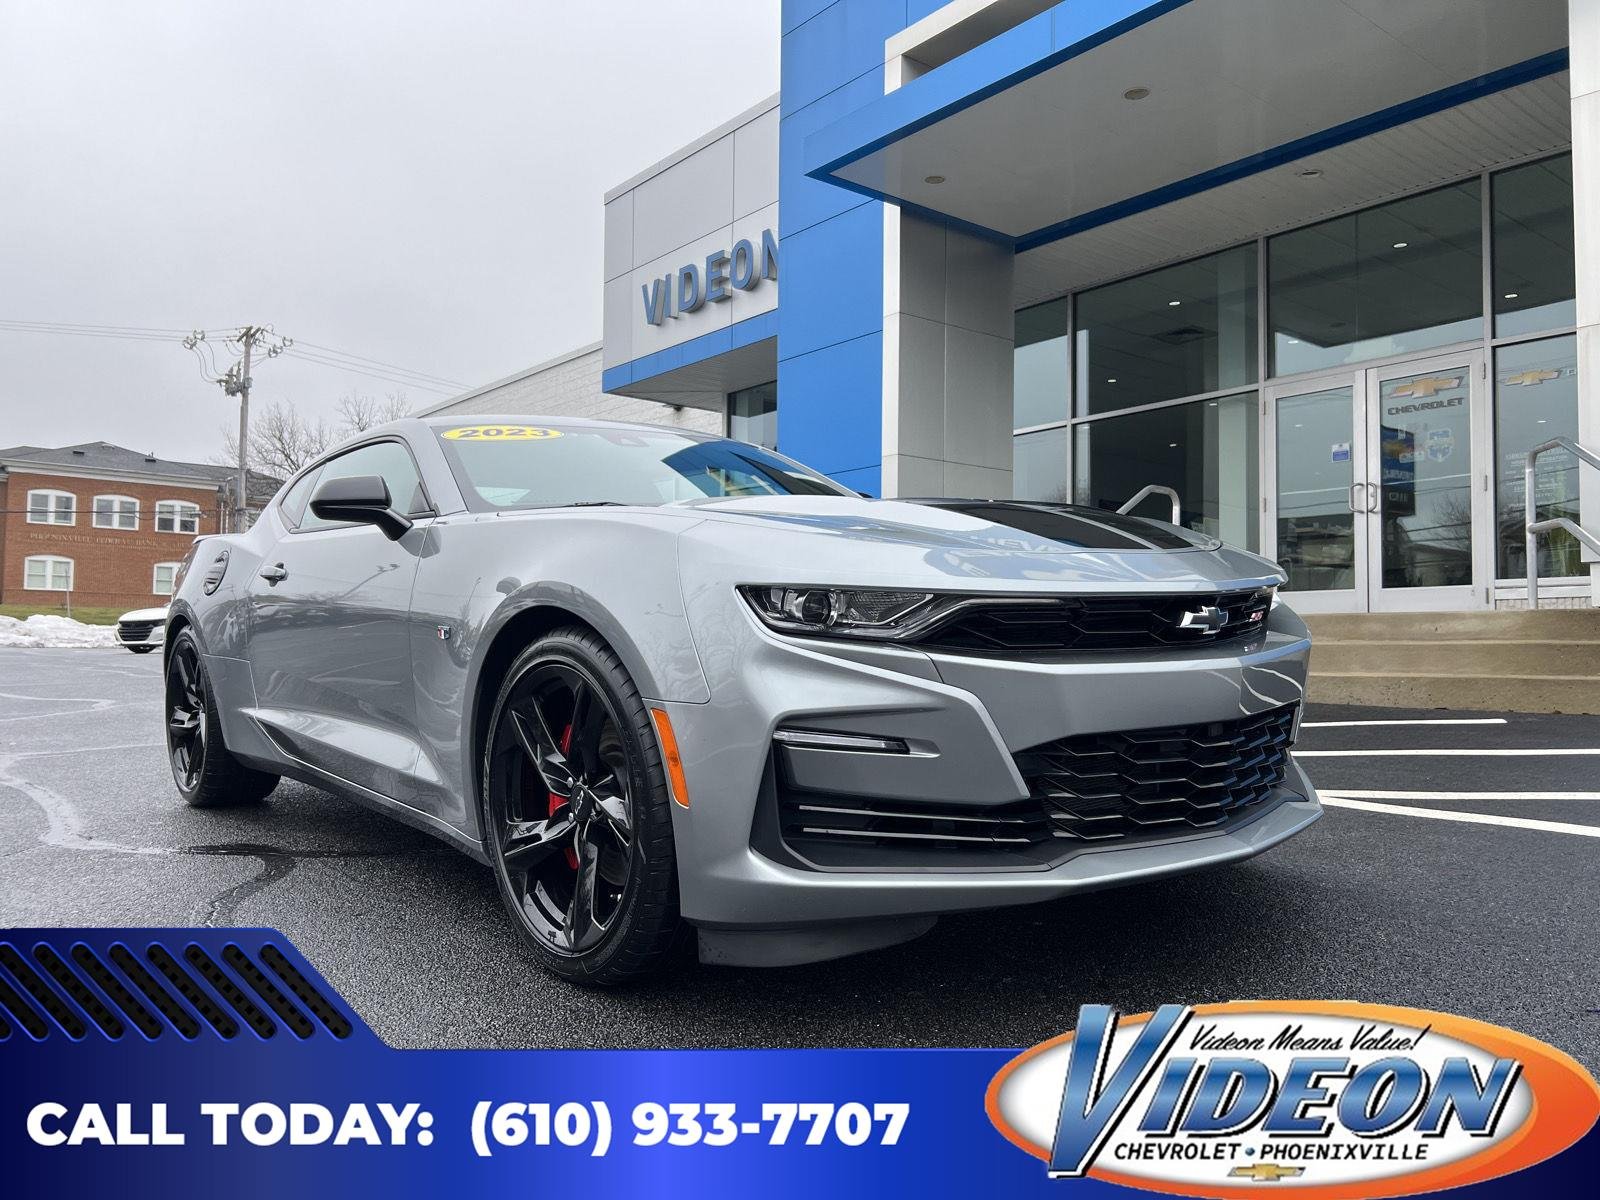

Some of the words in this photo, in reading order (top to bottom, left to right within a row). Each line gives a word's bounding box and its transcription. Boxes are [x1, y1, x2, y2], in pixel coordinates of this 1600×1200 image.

[641, 228, 779, 326] VIDEON
[1387, 397, 1465, 416] CHEVROLET
[457, 427, 551, 438] 2023
